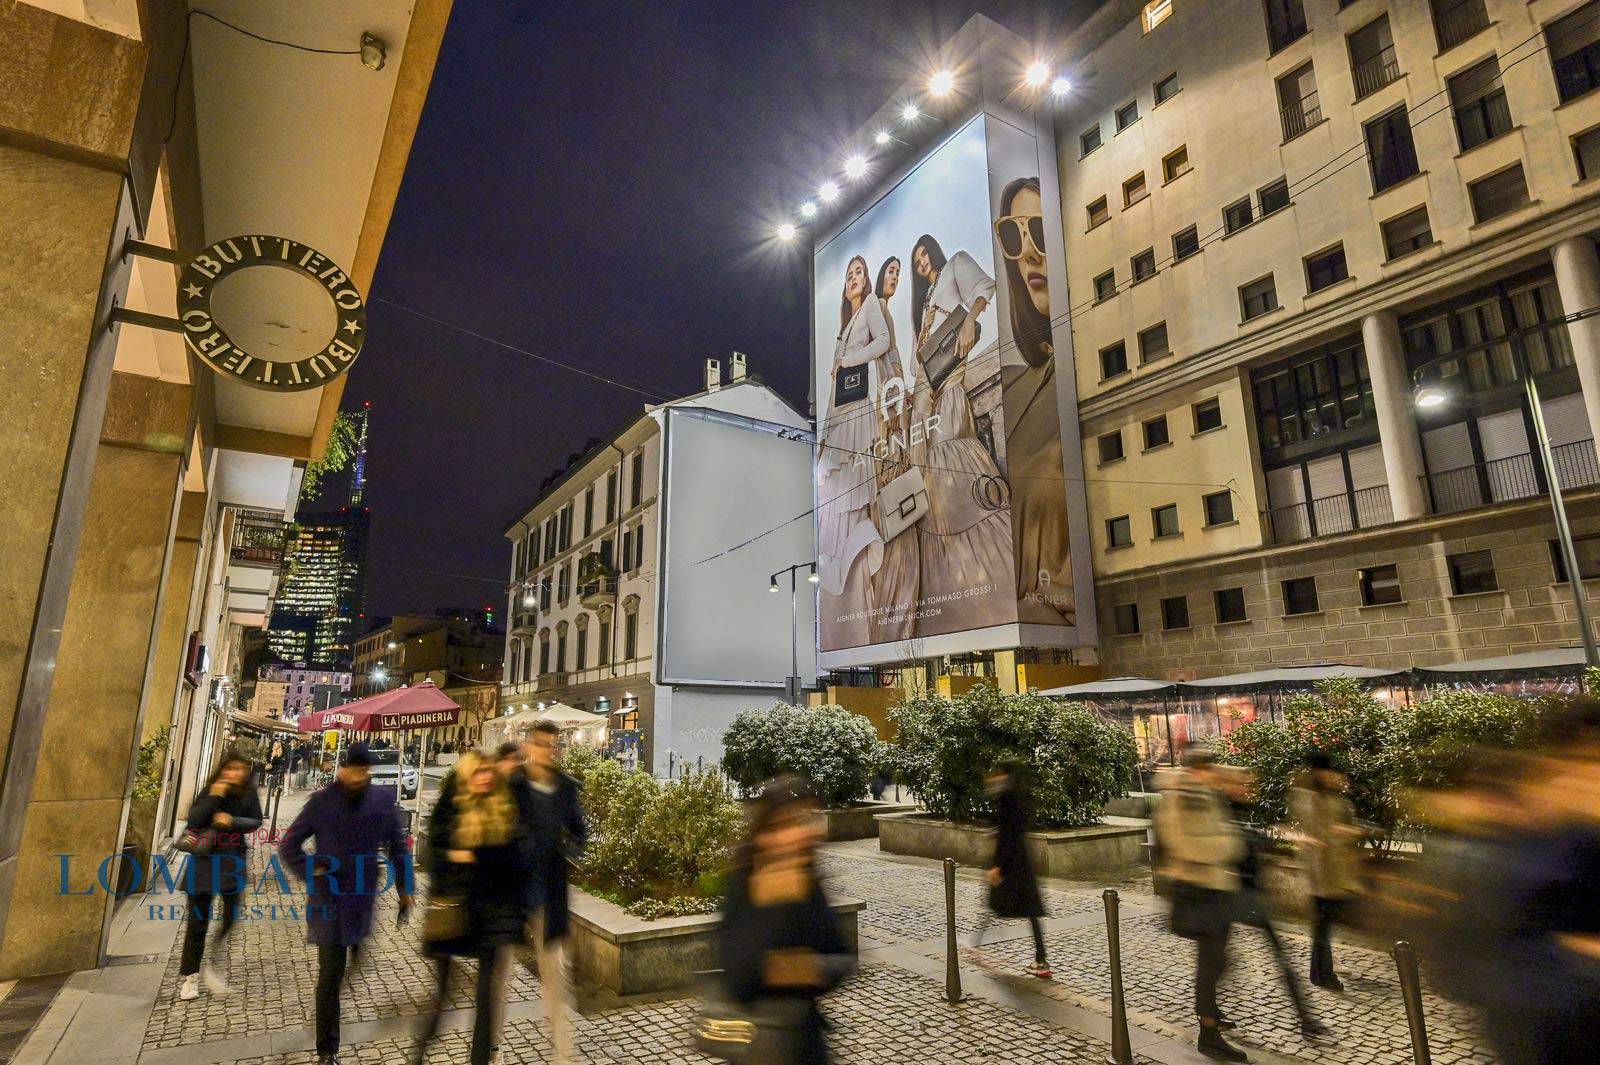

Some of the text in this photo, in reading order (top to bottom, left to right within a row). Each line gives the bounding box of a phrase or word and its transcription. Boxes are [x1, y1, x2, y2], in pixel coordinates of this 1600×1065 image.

[190, 236, 361, 310] BUTTERO
[182, 310, 356, 385] BUTTERO
[851, 414, 943, 473] AIGNER
[915, 599, 926, 607] VIA
[927, 591, 962, 606] TOMMASO
[964, 585, 992, 598] GROSSI
[1023, 592, 1068, 606] AIGNER
[384, 711, 454, 727] LA PIADINERIA
